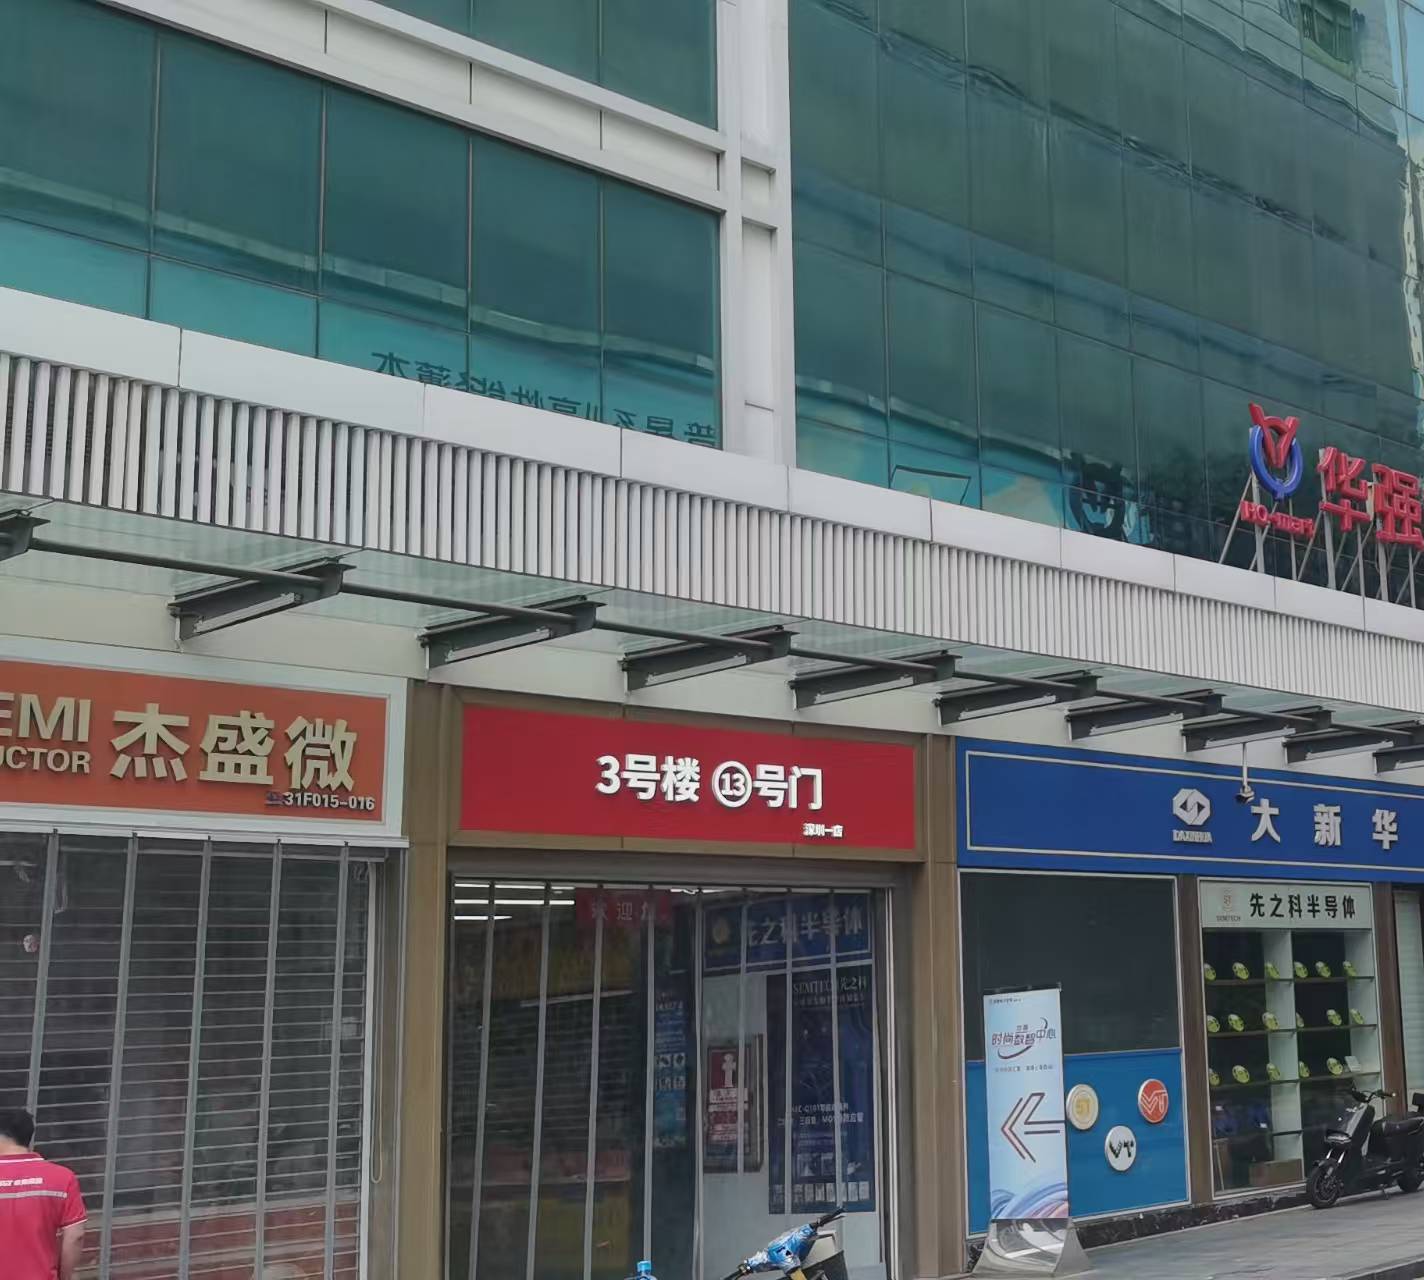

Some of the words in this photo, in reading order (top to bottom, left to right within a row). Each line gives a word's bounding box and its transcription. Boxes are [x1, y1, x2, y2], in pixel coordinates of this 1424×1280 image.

[109, 702, 359, 793] 杰盛微
[595, 754, 700, 803] 3号楼
[282, 791, 376, 811] 31F015-016
[1249, 893, 1356, 920] 先之科半导体
